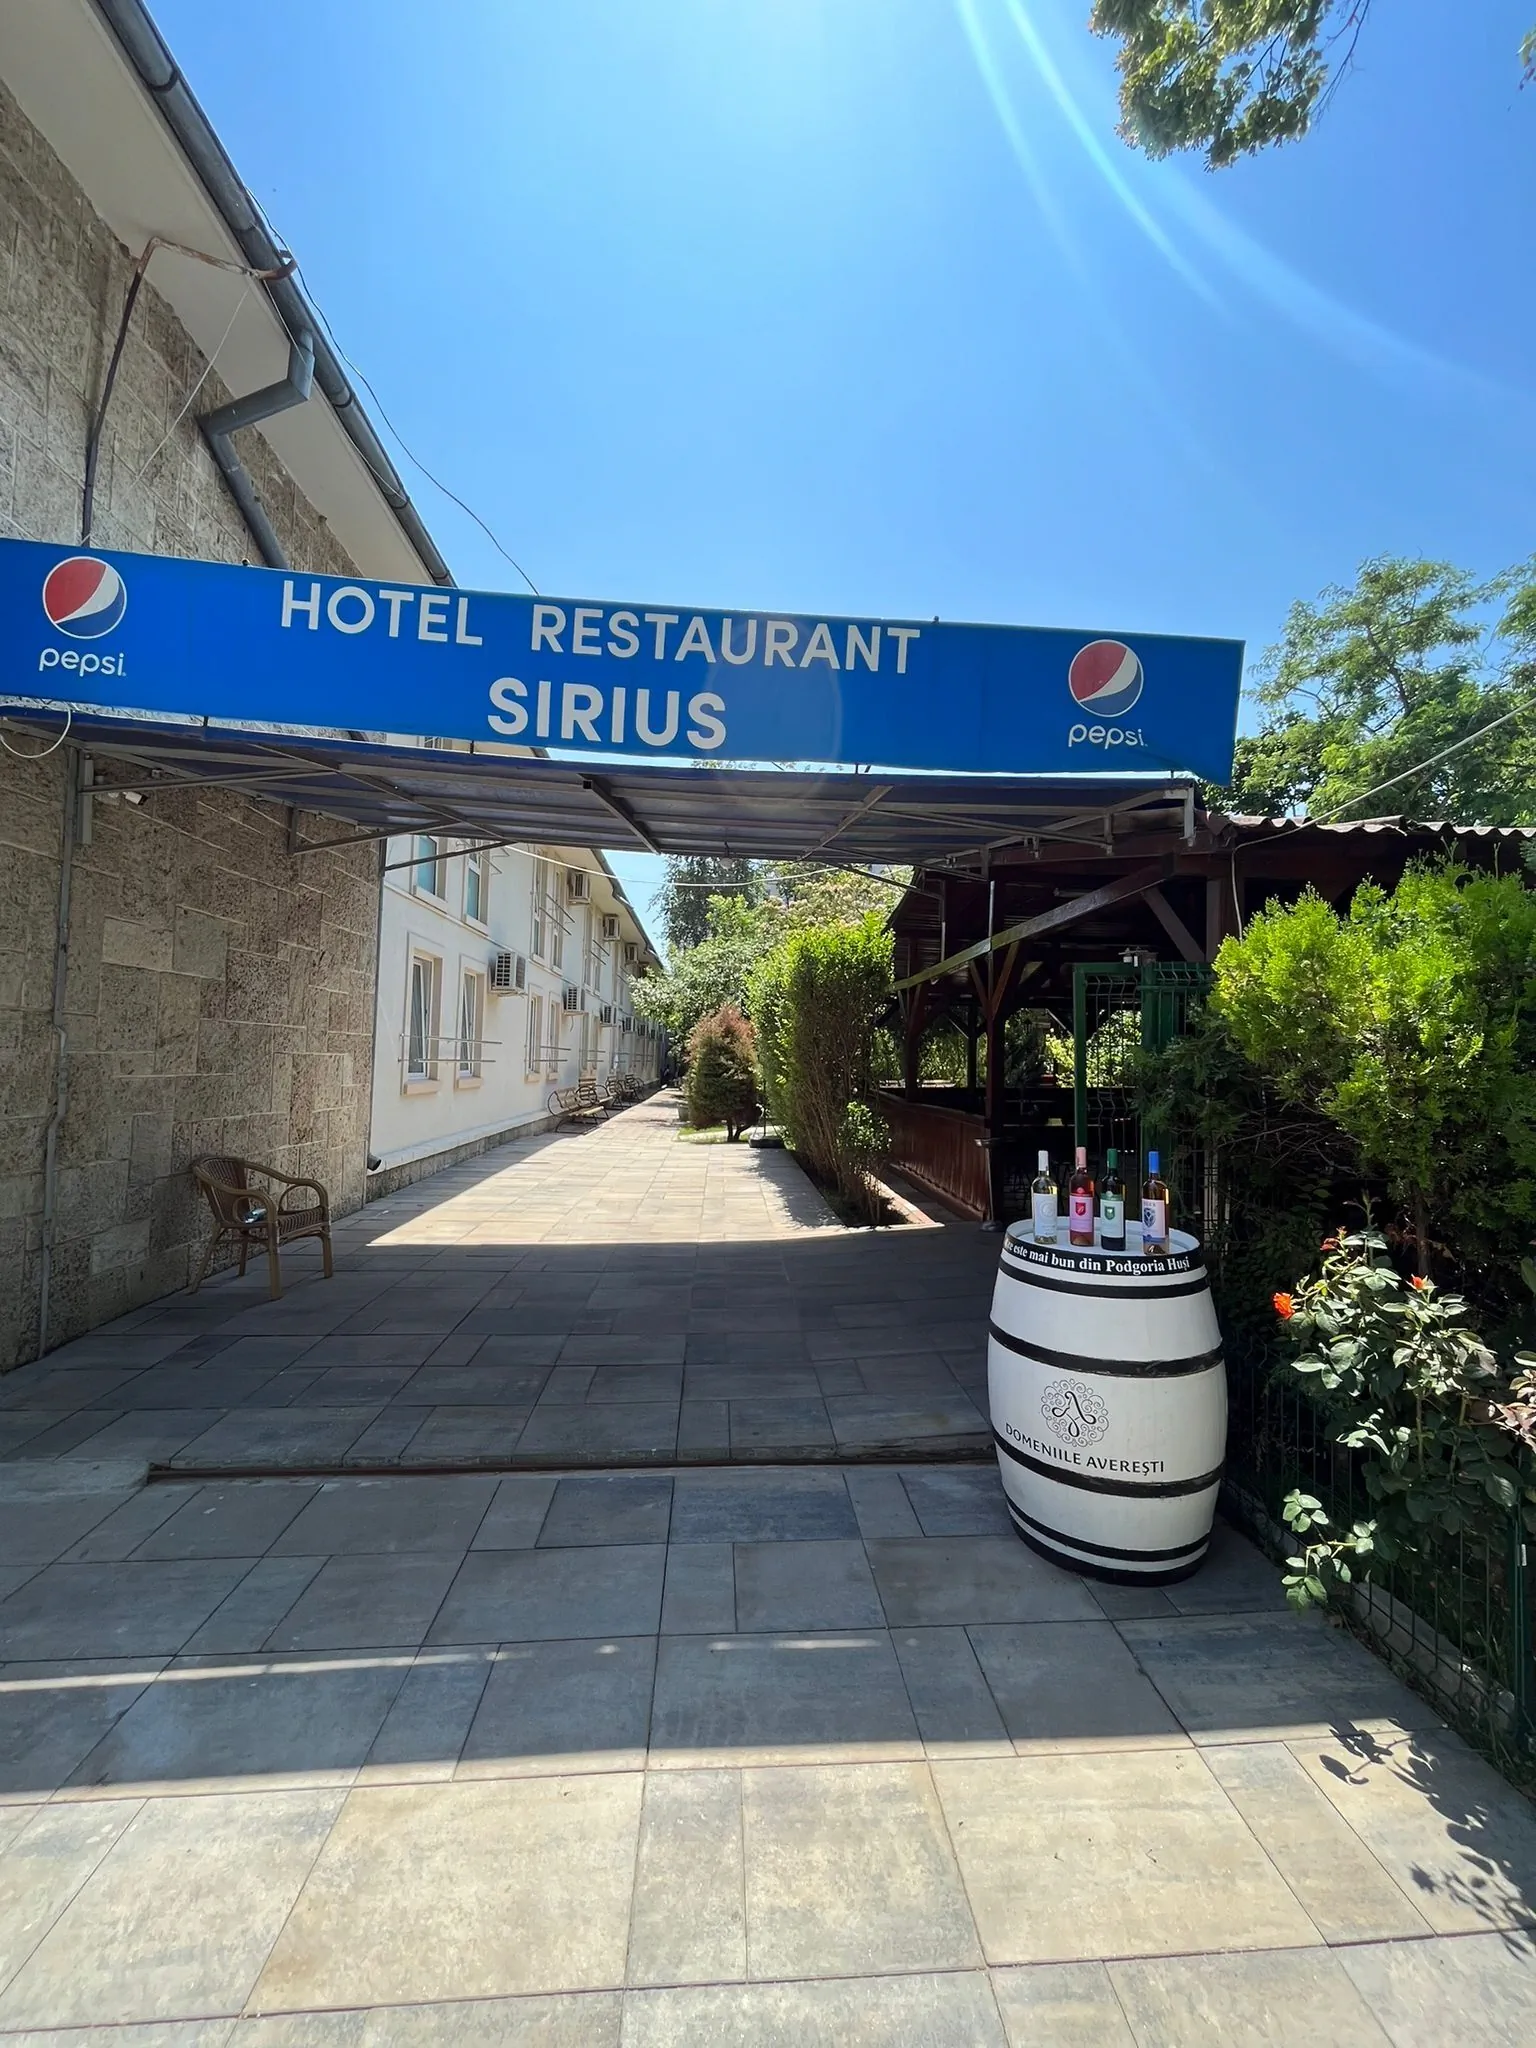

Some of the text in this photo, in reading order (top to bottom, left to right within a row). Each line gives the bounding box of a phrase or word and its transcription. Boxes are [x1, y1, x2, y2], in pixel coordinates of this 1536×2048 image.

[281, 580, 921, 674] HOTEL RESTAURANT
[38, 647, 126, 677] pepsi
[487, 677, 727, 750] SIRIUS
[1068, 723, 1146, 749] pepsi
[1013, 1245, 1028, 1257] este
[1029, 1250, 1049, 1264] mai
[1051, 1253, 1076, 1269] bun
[1079, 1256, 1101, 1271] din
[1105, 1259, 1166, 1276] Podgoria
[1005, 1422, 1082, 1466] DOMENIILE
